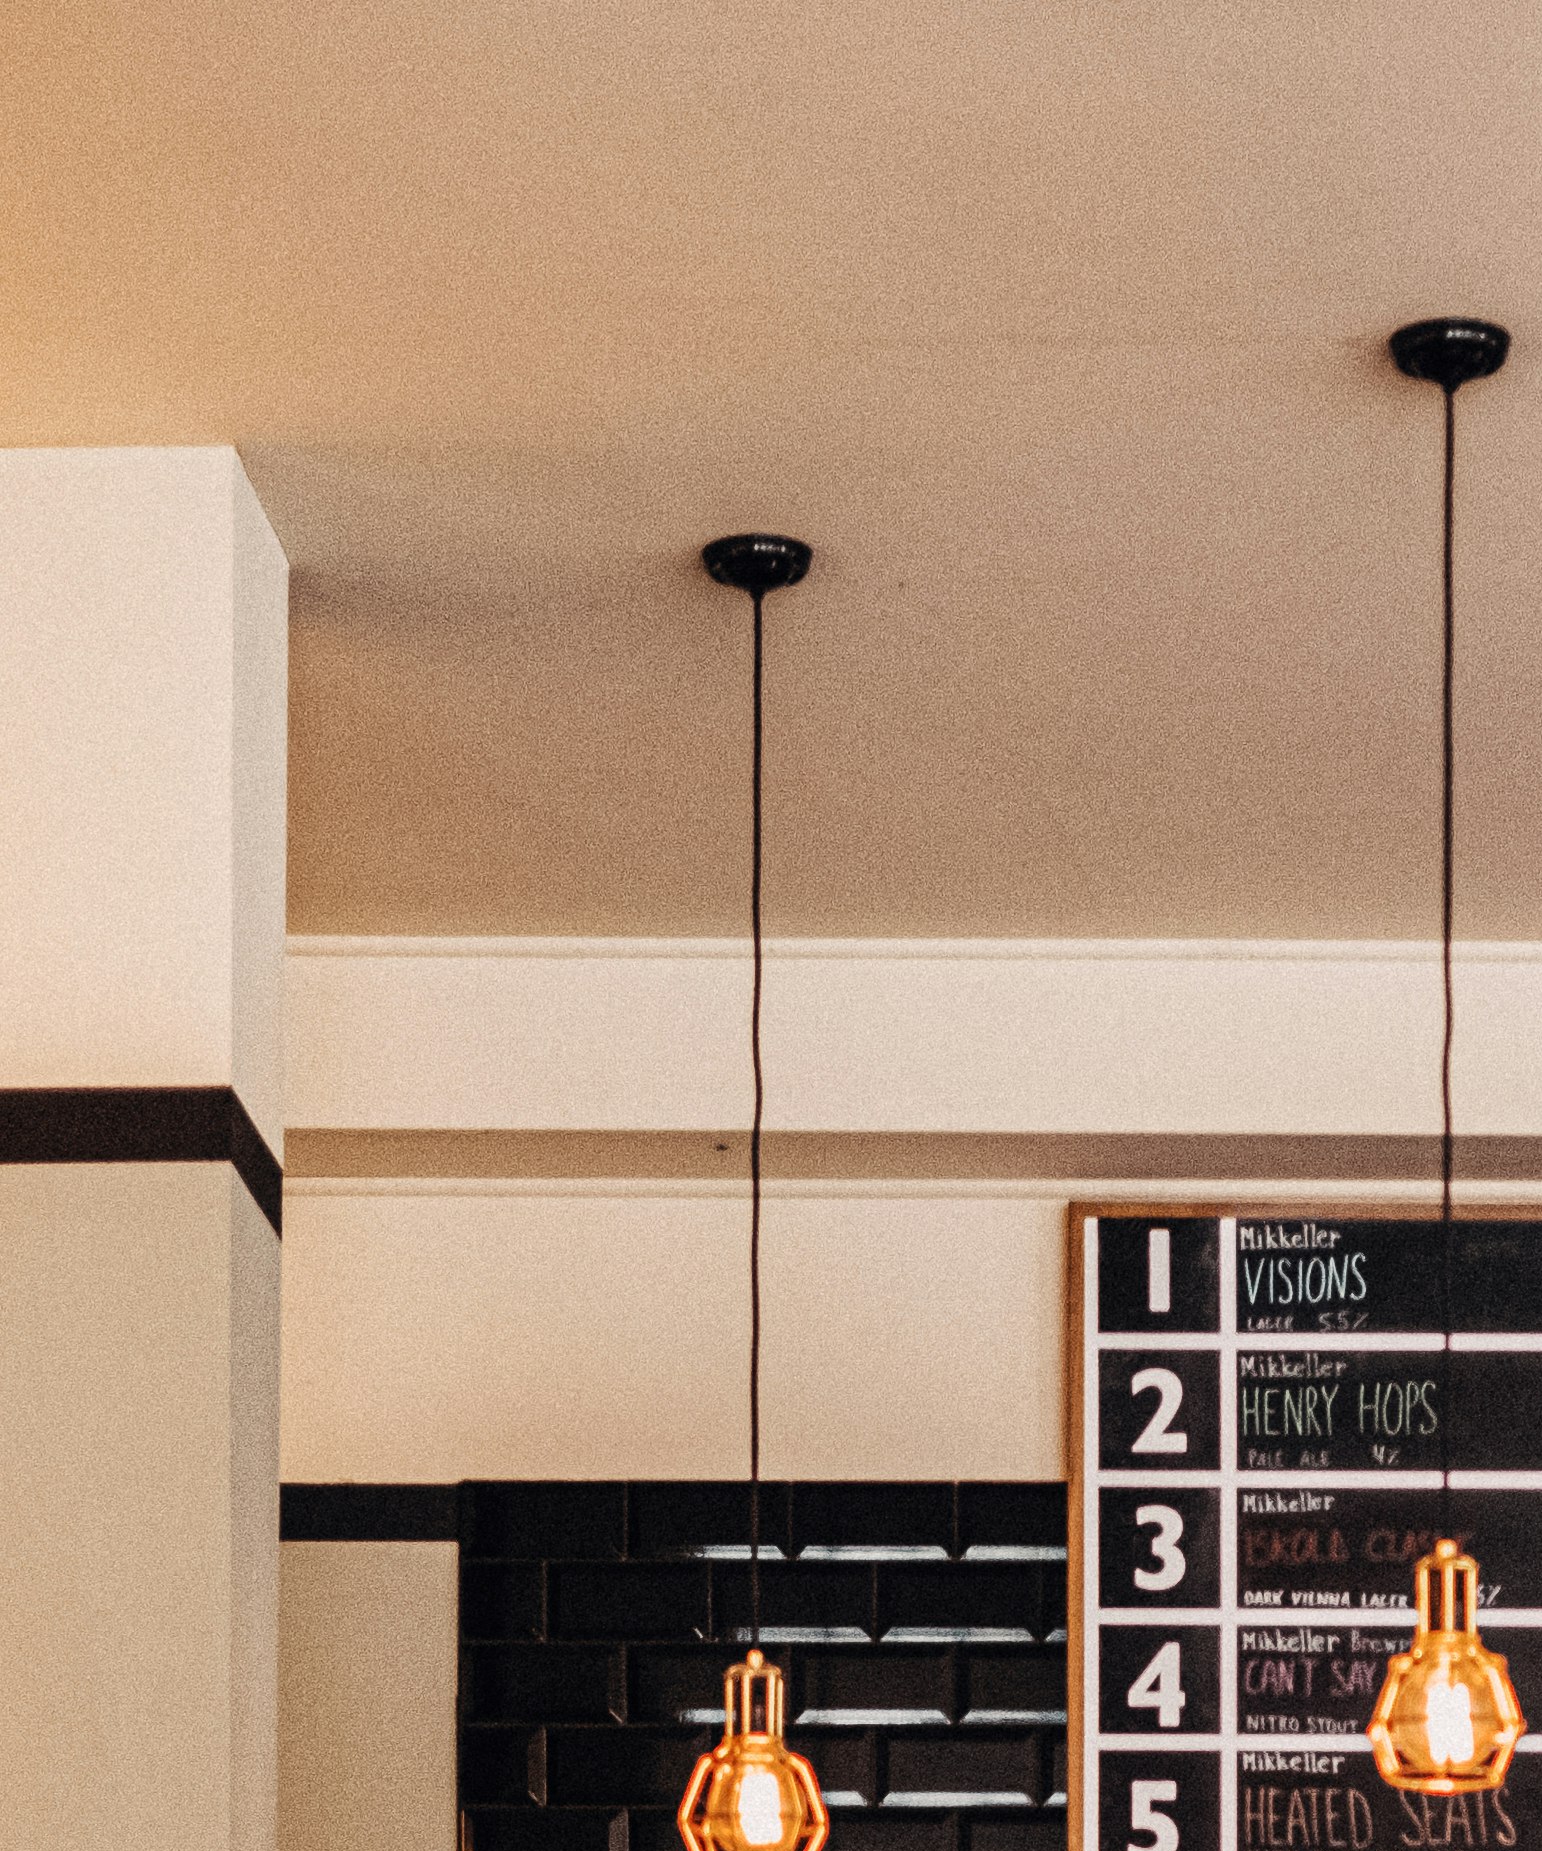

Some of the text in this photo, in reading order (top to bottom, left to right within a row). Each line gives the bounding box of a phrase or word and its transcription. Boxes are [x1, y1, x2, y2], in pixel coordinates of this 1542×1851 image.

[1240, 1227, 1341, 1251] Mikkeller
[1149, 1228, 1170, 1312] 1
[1243, 1252, 1367, 1304] VISIONS
[1240, 1355, 1347, 1379] Mikkeller
[1131, 1367, 1188, 1454] 2
[1241, 1381, 1438, 1437] HENRY HOPS
[1242, 1492, 1336, 1514] Mikkeller
[1134, 1505, 1186, 1591] 3
[1243, 1590, 1282, 1608] DARK
[1242, 1631, 1340, 1653] Mikkeller
[1128, 1641, 1186, 1728] 4
[1329, 1658, 1377, 1698] SAY
[1246, 1715, 1358, 1733] NITRO STOUT
[1242, 1752, 1346, 1775] Mikkeller
[1245, 1788, 1517, 1850] HEATED SEATS
